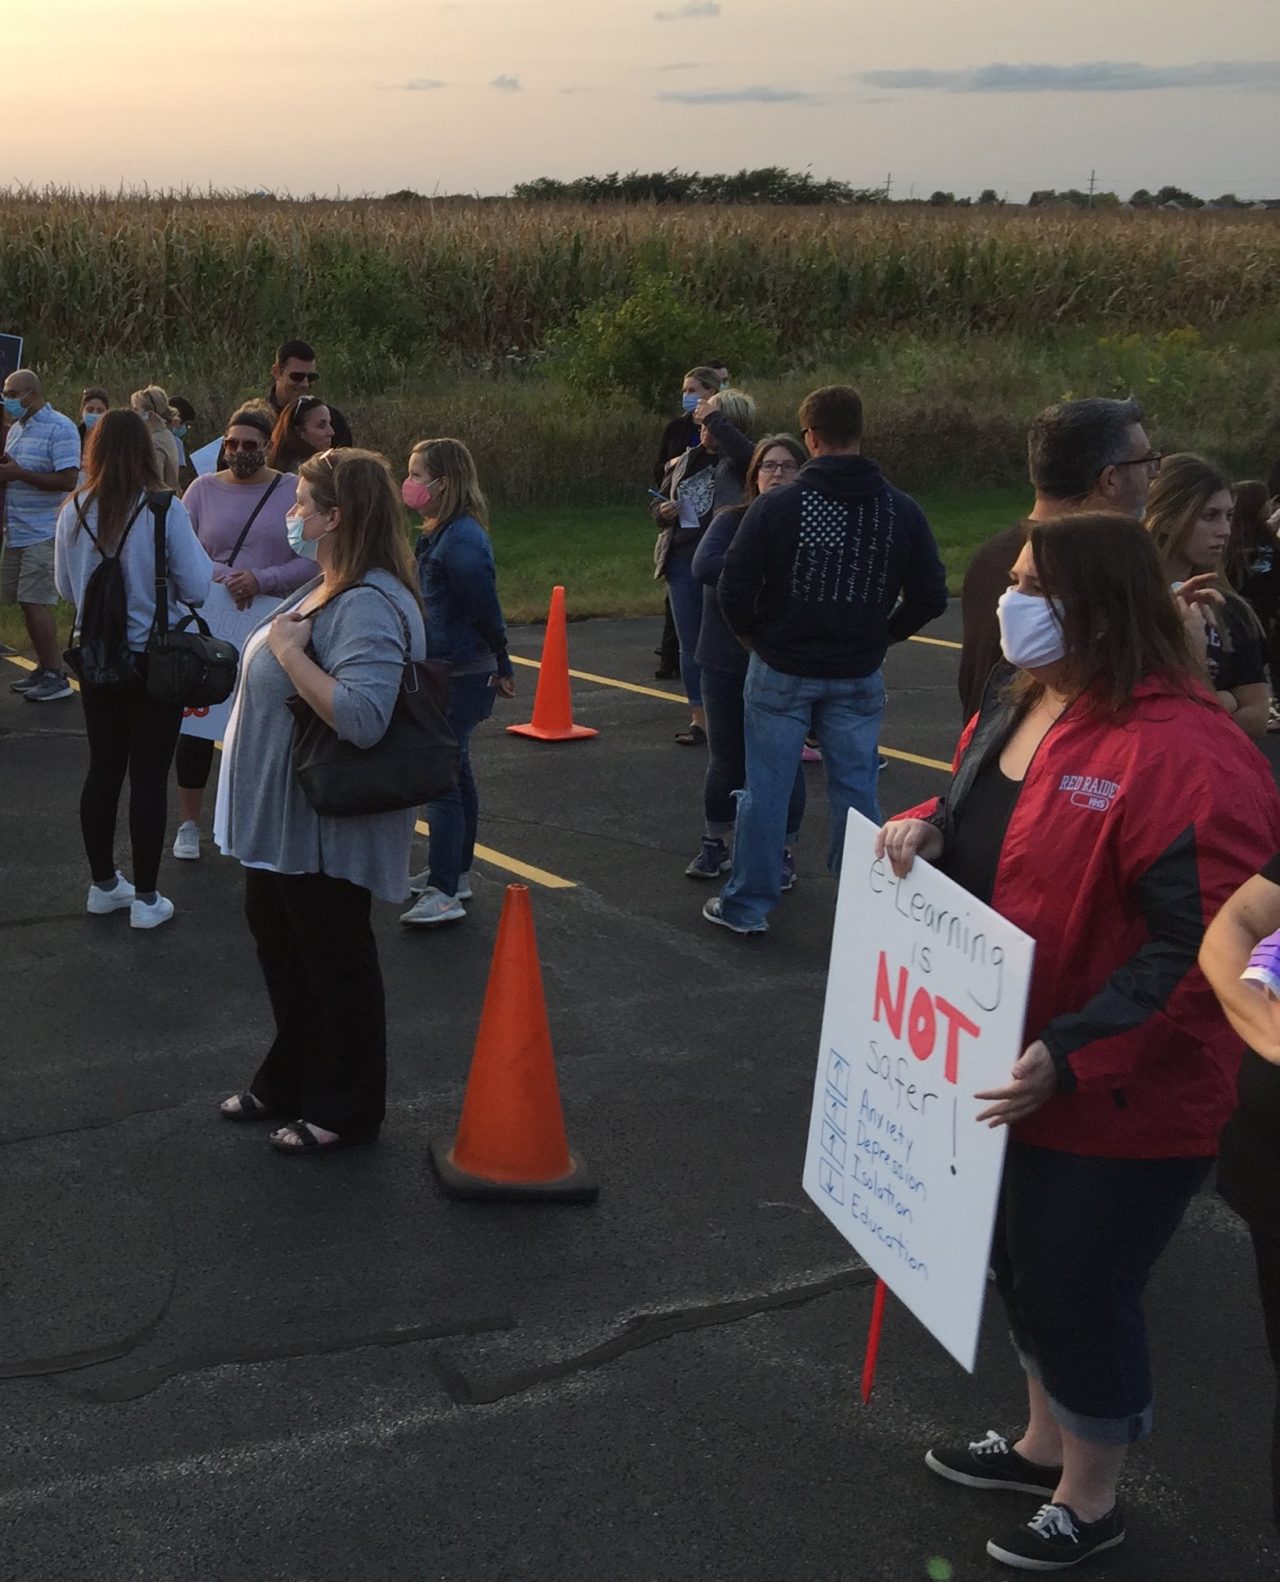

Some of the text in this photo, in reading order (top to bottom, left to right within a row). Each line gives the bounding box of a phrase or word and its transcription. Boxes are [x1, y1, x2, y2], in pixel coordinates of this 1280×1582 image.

[1059, 775, 1120, 799] RED RAIDE
[873, 950, 981, 1085] NOT
[856, 1119, 927, 1202] Depression
[859, 1088, 913, 1164] Anxiety
[851, 1153, 913, 1224] Isolation
[850, 1193, 929, 1281] Education
